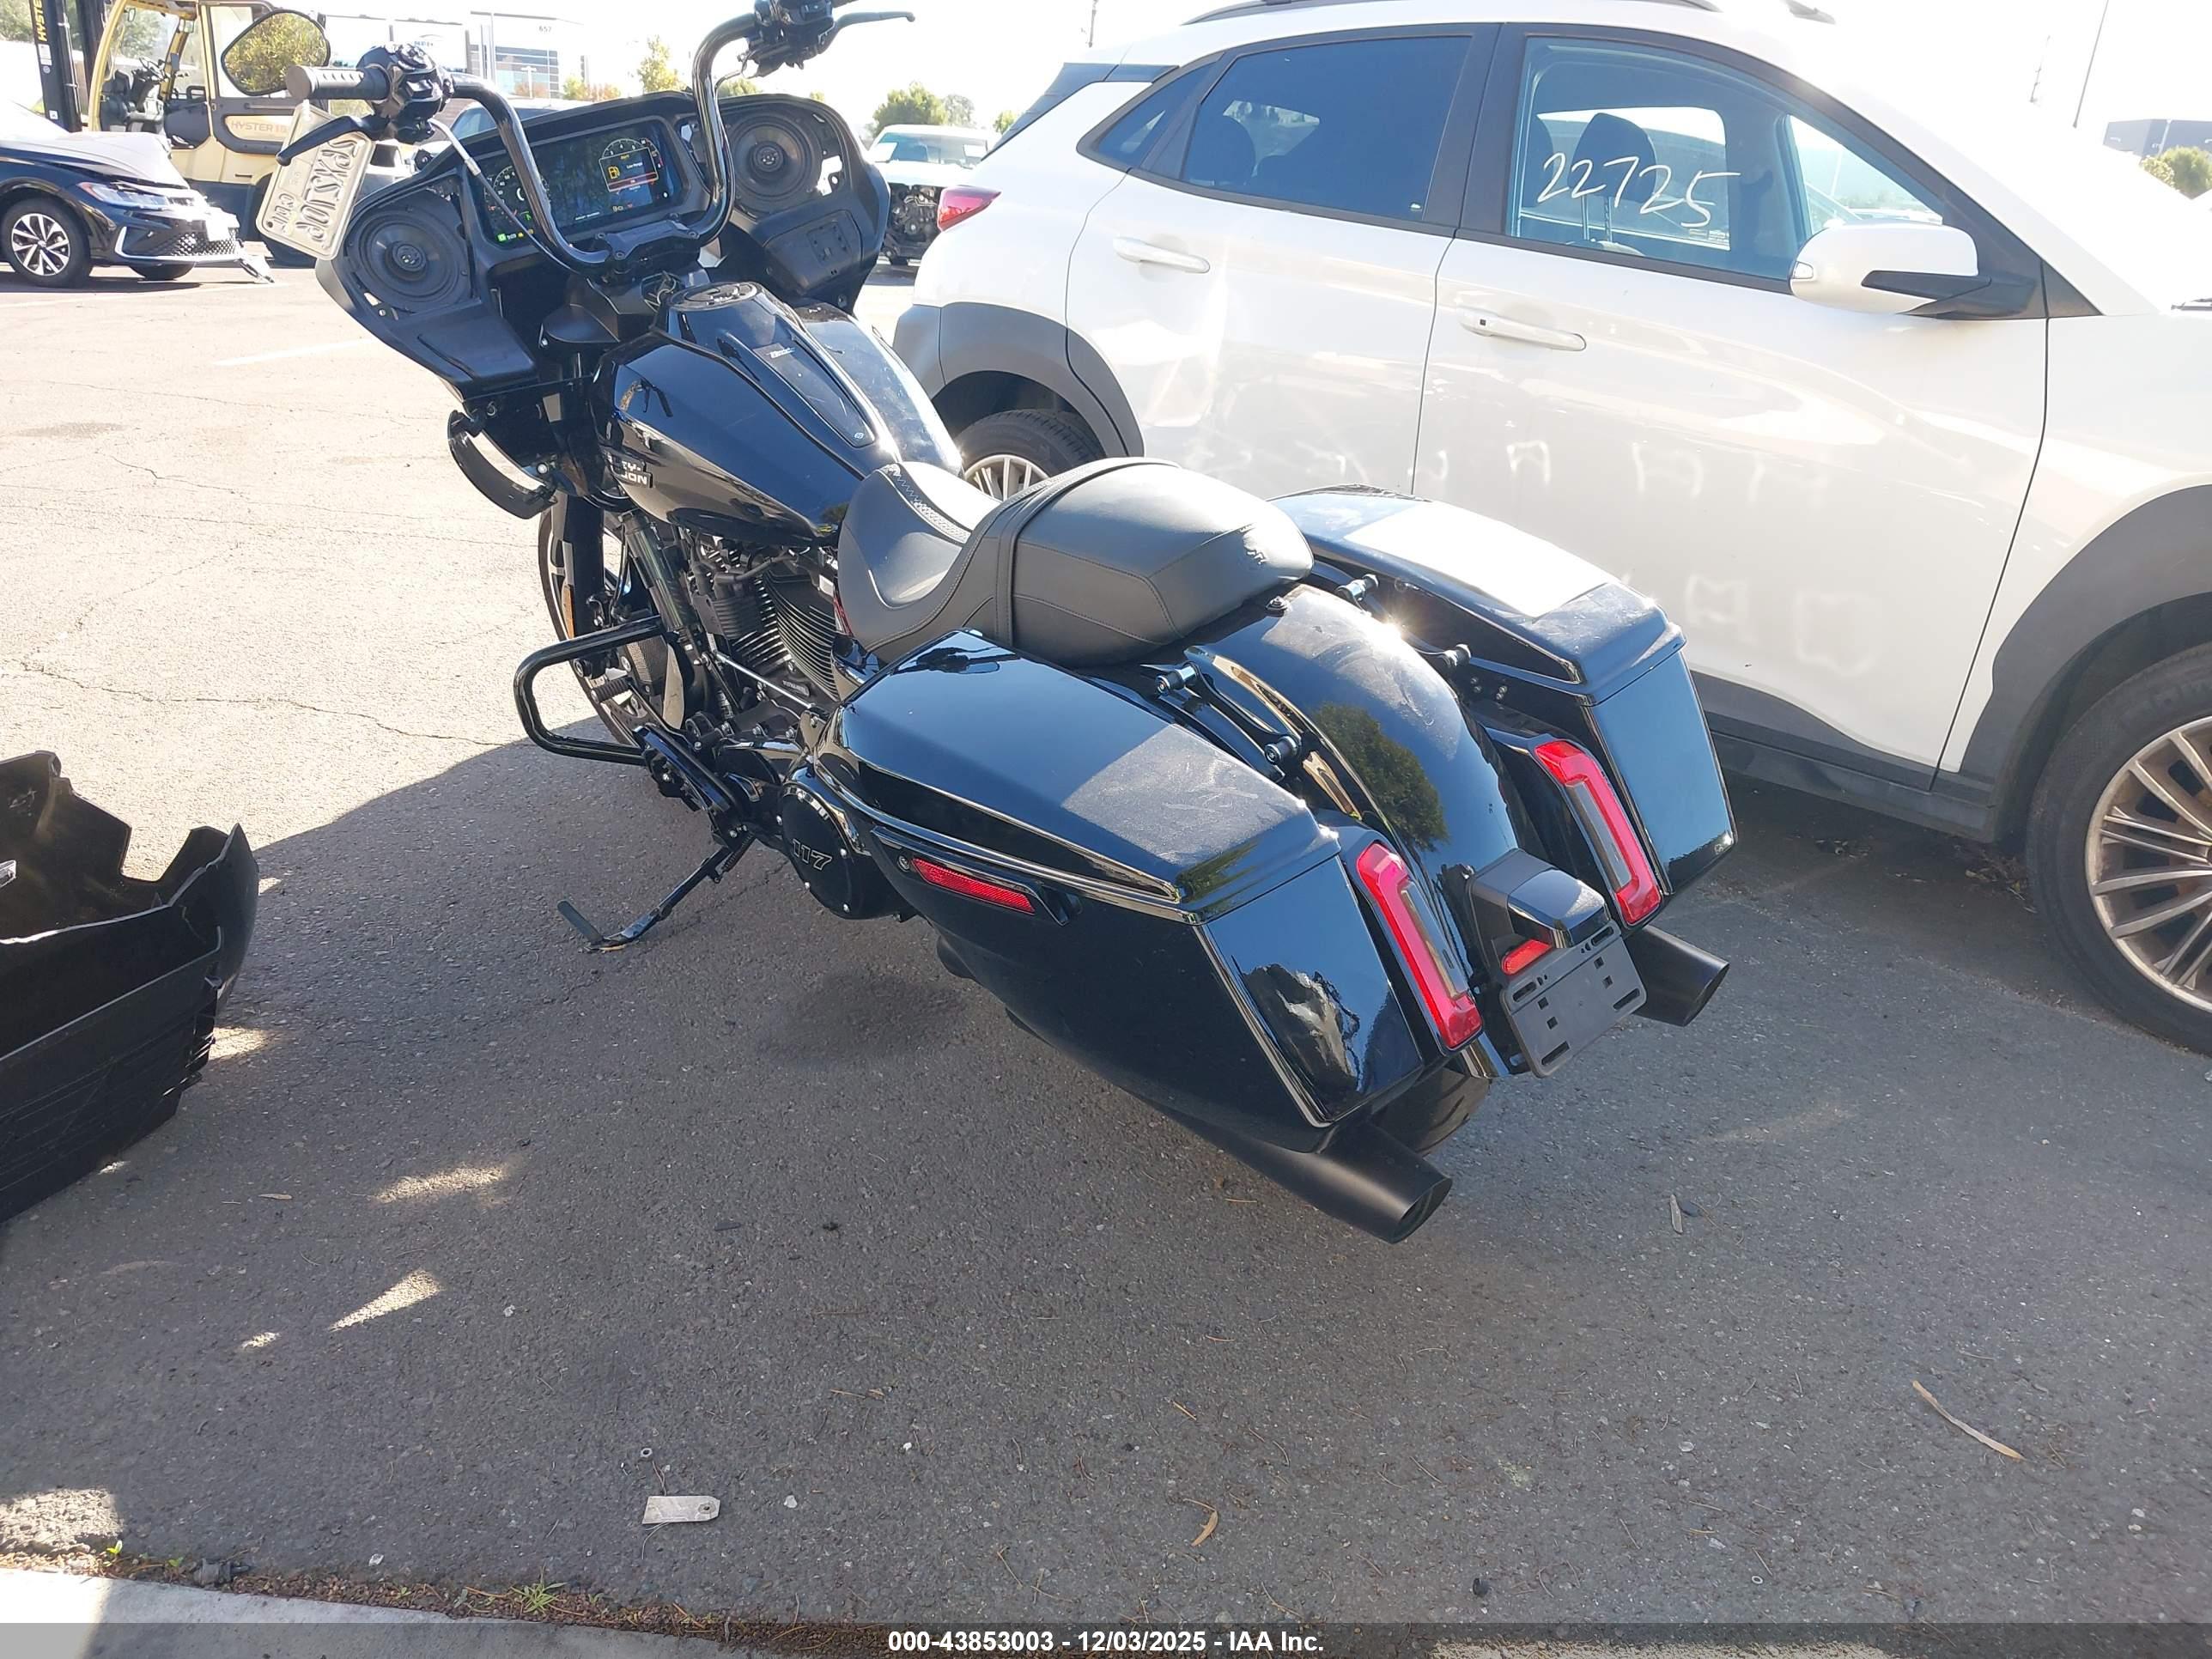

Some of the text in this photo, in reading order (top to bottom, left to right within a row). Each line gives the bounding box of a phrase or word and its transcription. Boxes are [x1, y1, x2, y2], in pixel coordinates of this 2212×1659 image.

[231, 120, 273, 132] HYSTER
[1536, 152, 1741, 228] 22725
[792, 838, 833, 871] 117
